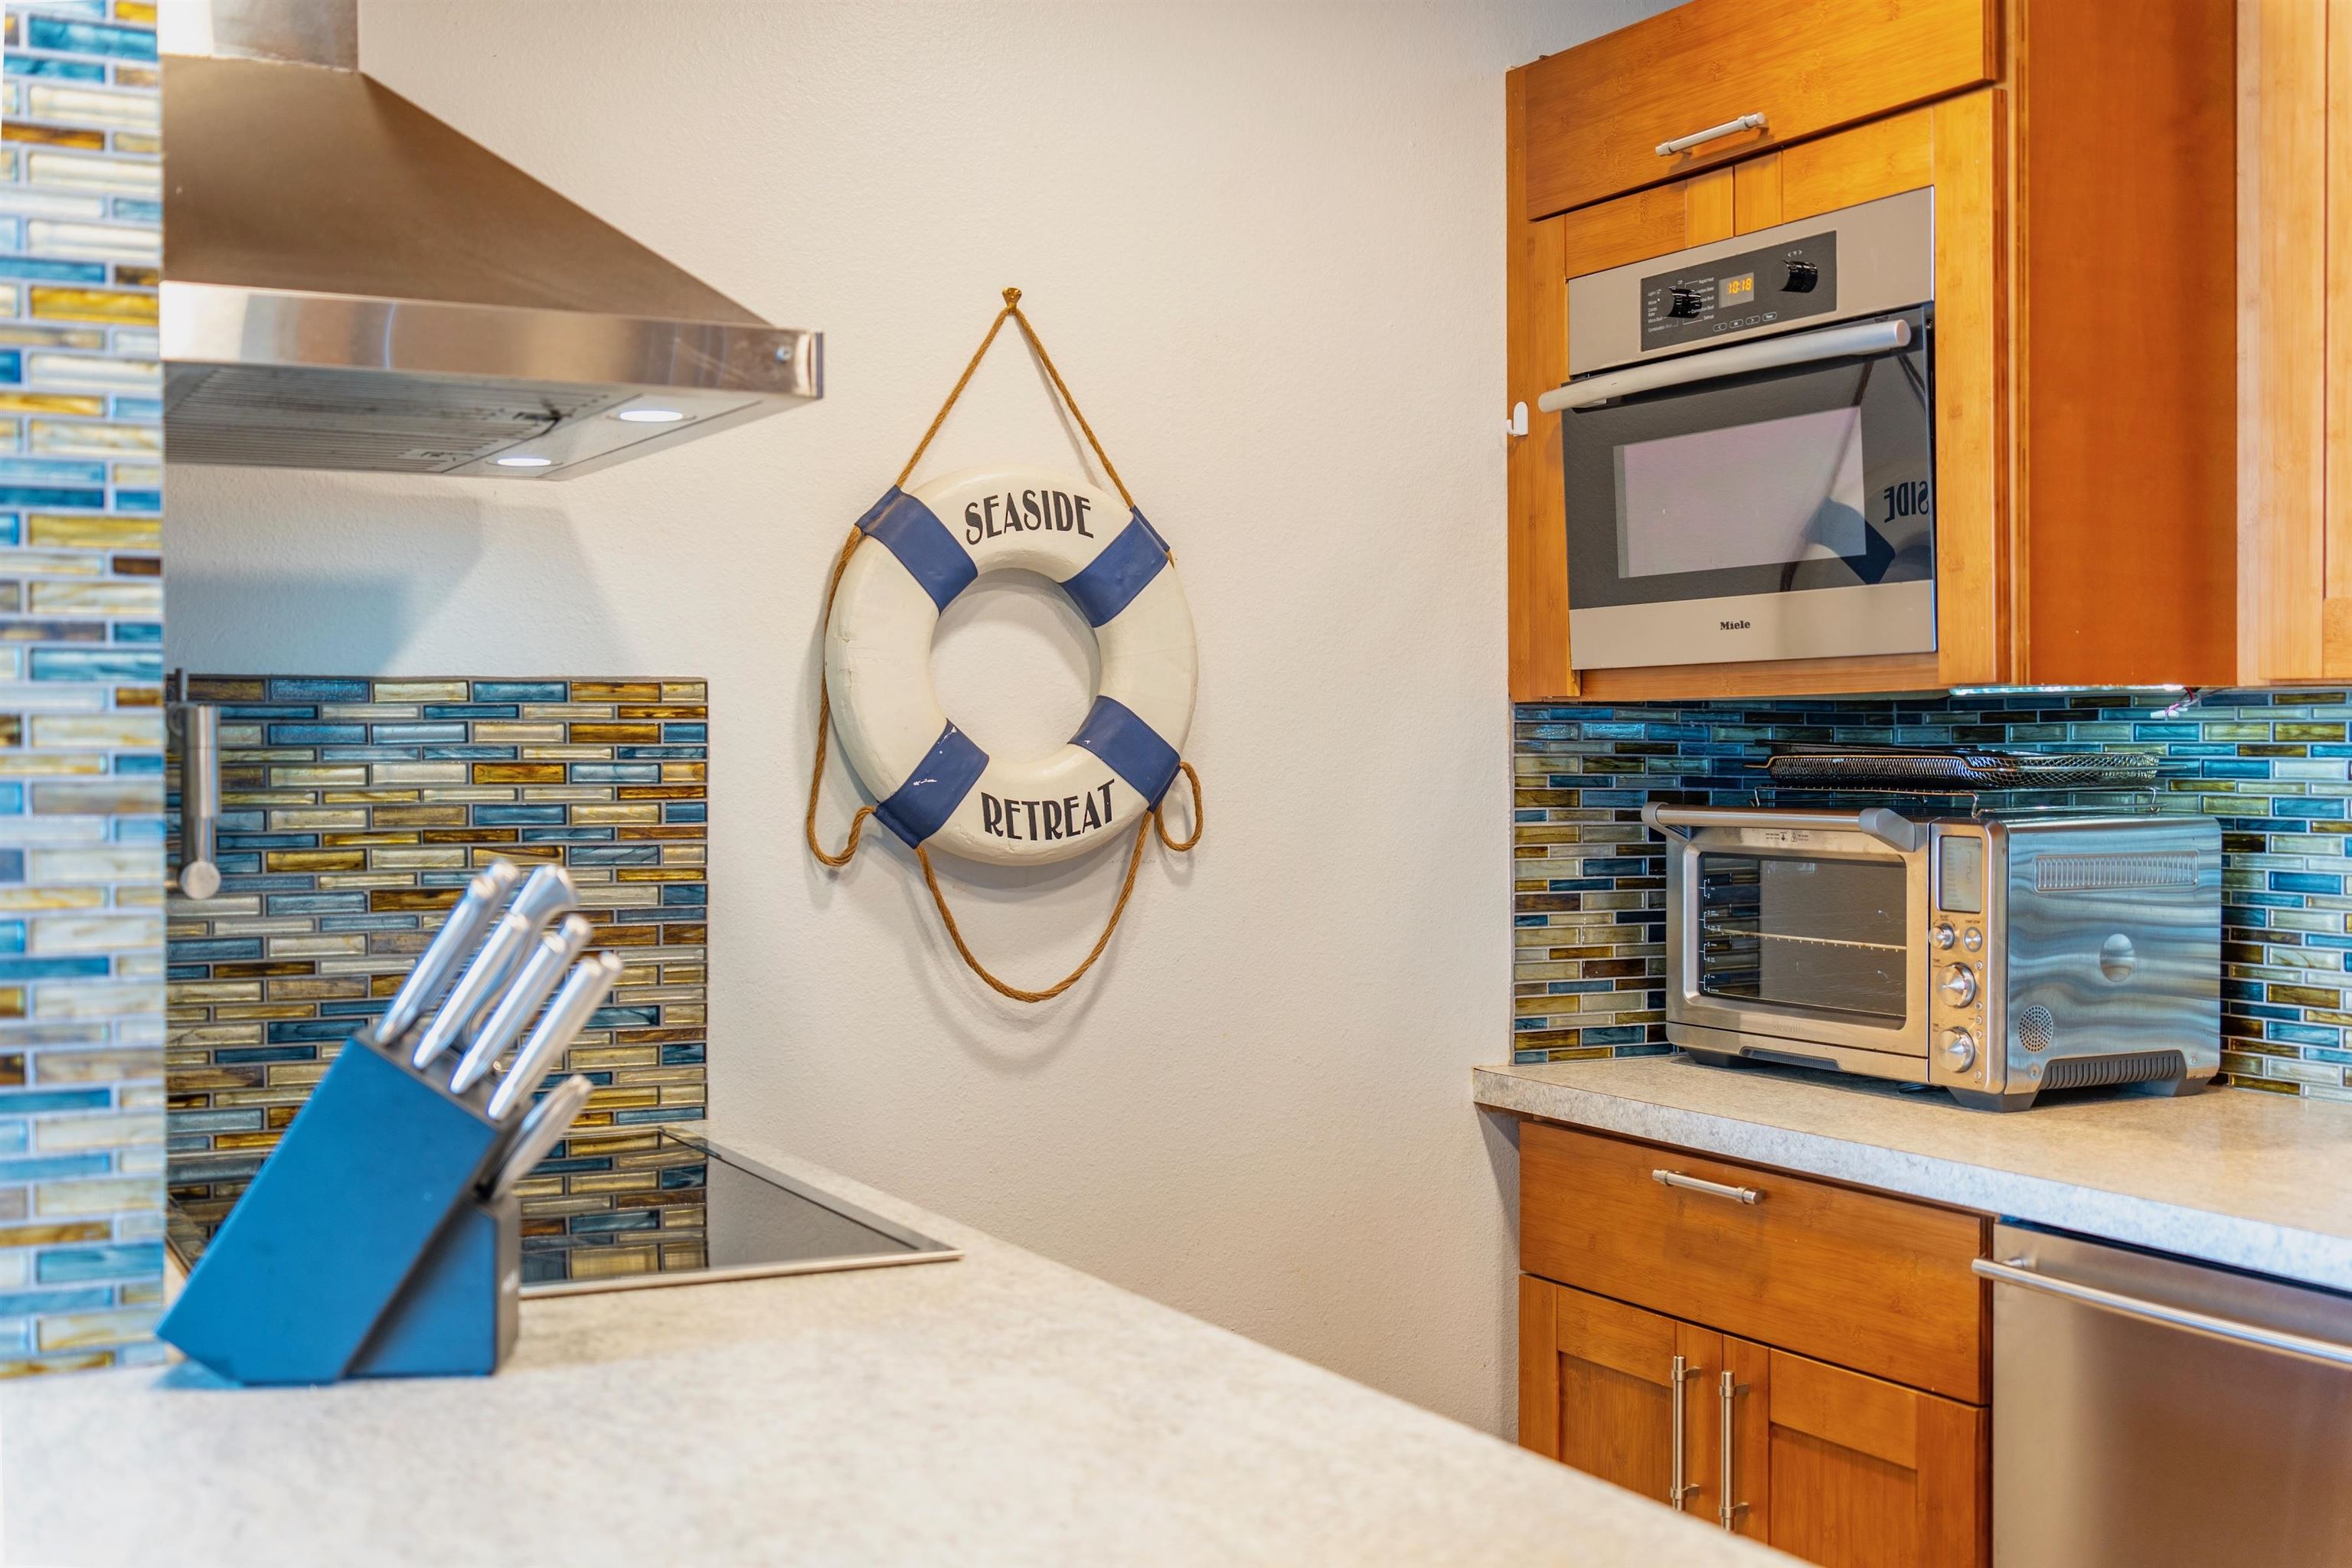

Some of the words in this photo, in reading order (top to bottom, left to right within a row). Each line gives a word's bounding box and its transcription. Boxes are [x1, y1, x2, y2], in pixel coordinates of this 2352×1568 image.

[1728, 278, 1752, 294] 10:18
[965, 489, 1094, 545] SEASIDE
[1720, 619, 1751, 630] Miele
[981, 779, 1116, 841] RETREAT
